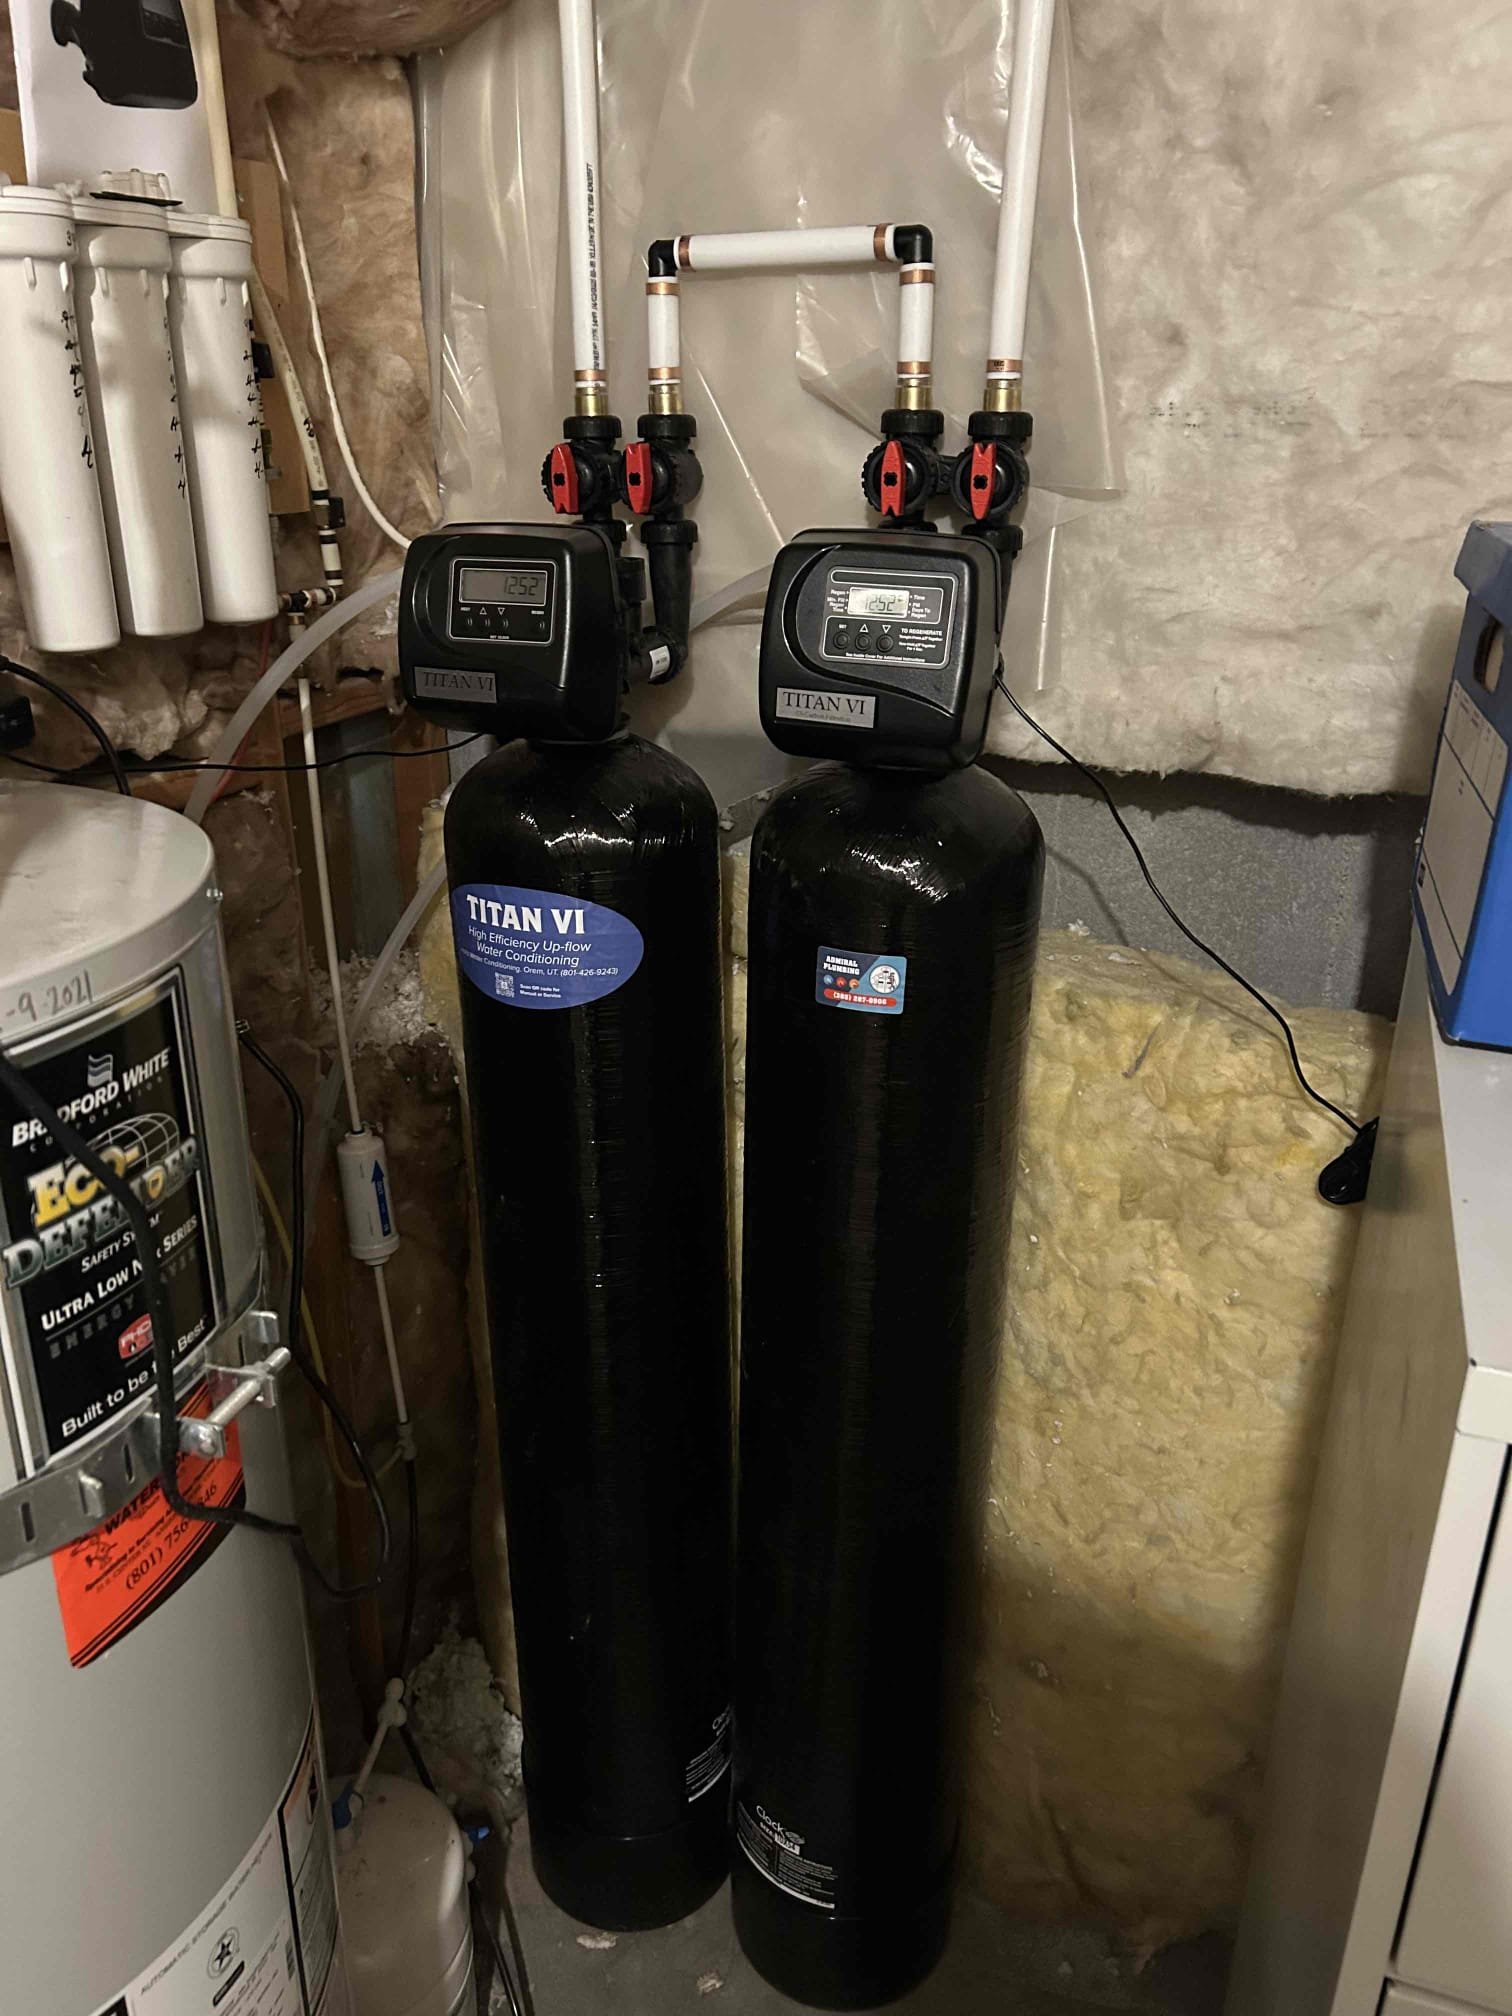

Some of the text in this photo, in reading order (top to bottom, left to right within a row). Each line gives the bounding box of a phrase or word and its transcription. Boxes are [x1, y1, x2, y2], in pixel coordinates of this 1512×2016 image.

[423, 671, 494, 692] TITAN VI
[782, 692, 866, 715] TITAN VI
[466, 894, 586, 935] TITAN VI
[468, 925, 487, 942] High
[488, 932, 541, 953] Efficiency
[543, 939, 593, 954] Up-flow
[476, 941, 503, 957] Water
[505, 949, 581, 968] Conditioning
[823, 962, 860, 976] PLUMBING
[825, 955, 858, 968] ADMIRAL
[12, 1048, 170, 1147] BRDFORD WHITE
[162, 1214, 198, 1253] SERIES
[81, 1238, 120, 1273] SAFETY
[41, 1266, 129, 1331] ULTRA LOW
[177, 1319, 206, 1353] Best
[61, 1370, 149, 1438] Built to be
[104, 1475, 162, 1535] WATER
[125, 1547, 164, 1591] (801)
